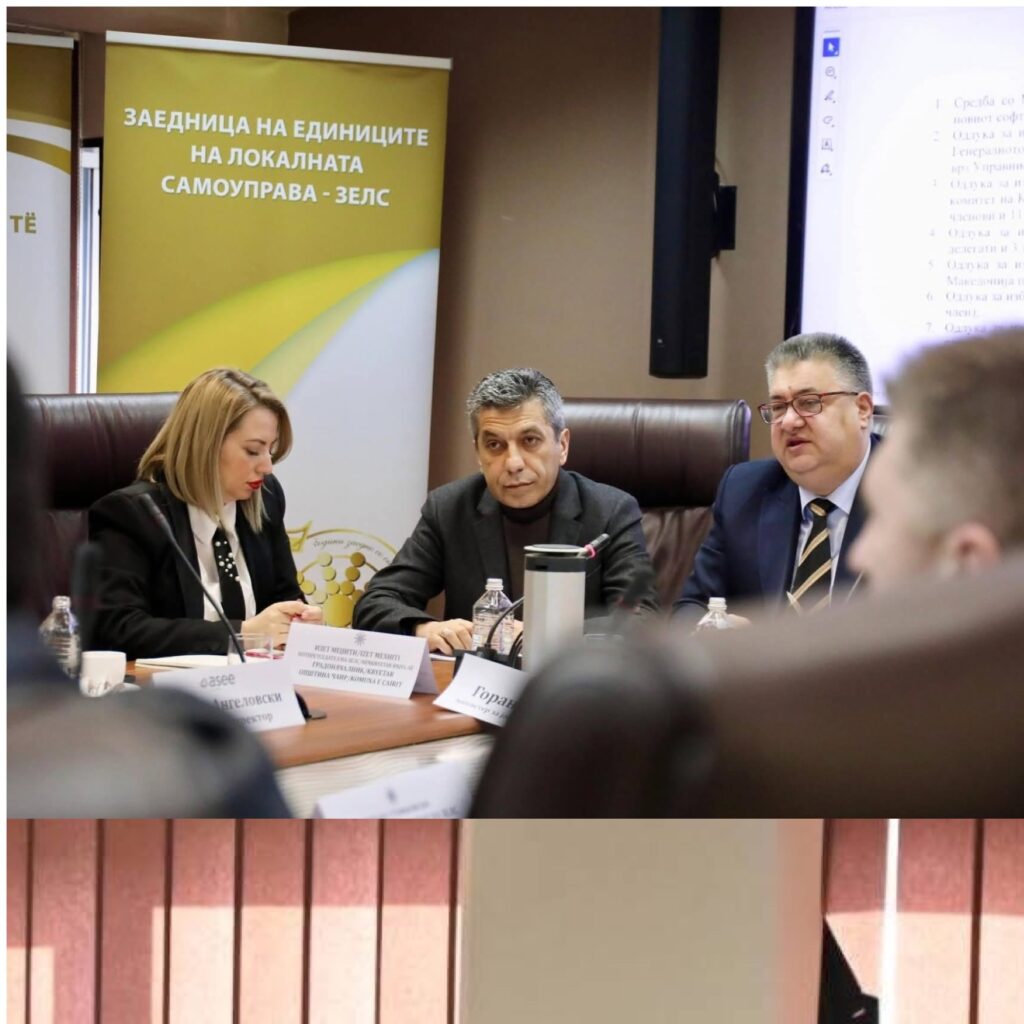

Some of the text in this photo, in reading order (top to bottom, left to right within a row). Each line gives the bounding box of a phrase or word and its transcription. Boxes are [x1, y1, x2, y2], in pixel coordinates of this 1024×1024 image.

[123, 107, 429, 147] ЗАЕДНИЦА НА ЕДИНИЦИТЕ
[191, 145, 364, 174] НА ЛОКАЛНАТА
[161, 175, 318, 202] САМОУПРАВА
[335, 186, 391, 207] ЗЕЛС
[10, 212, 37, 234] TË
